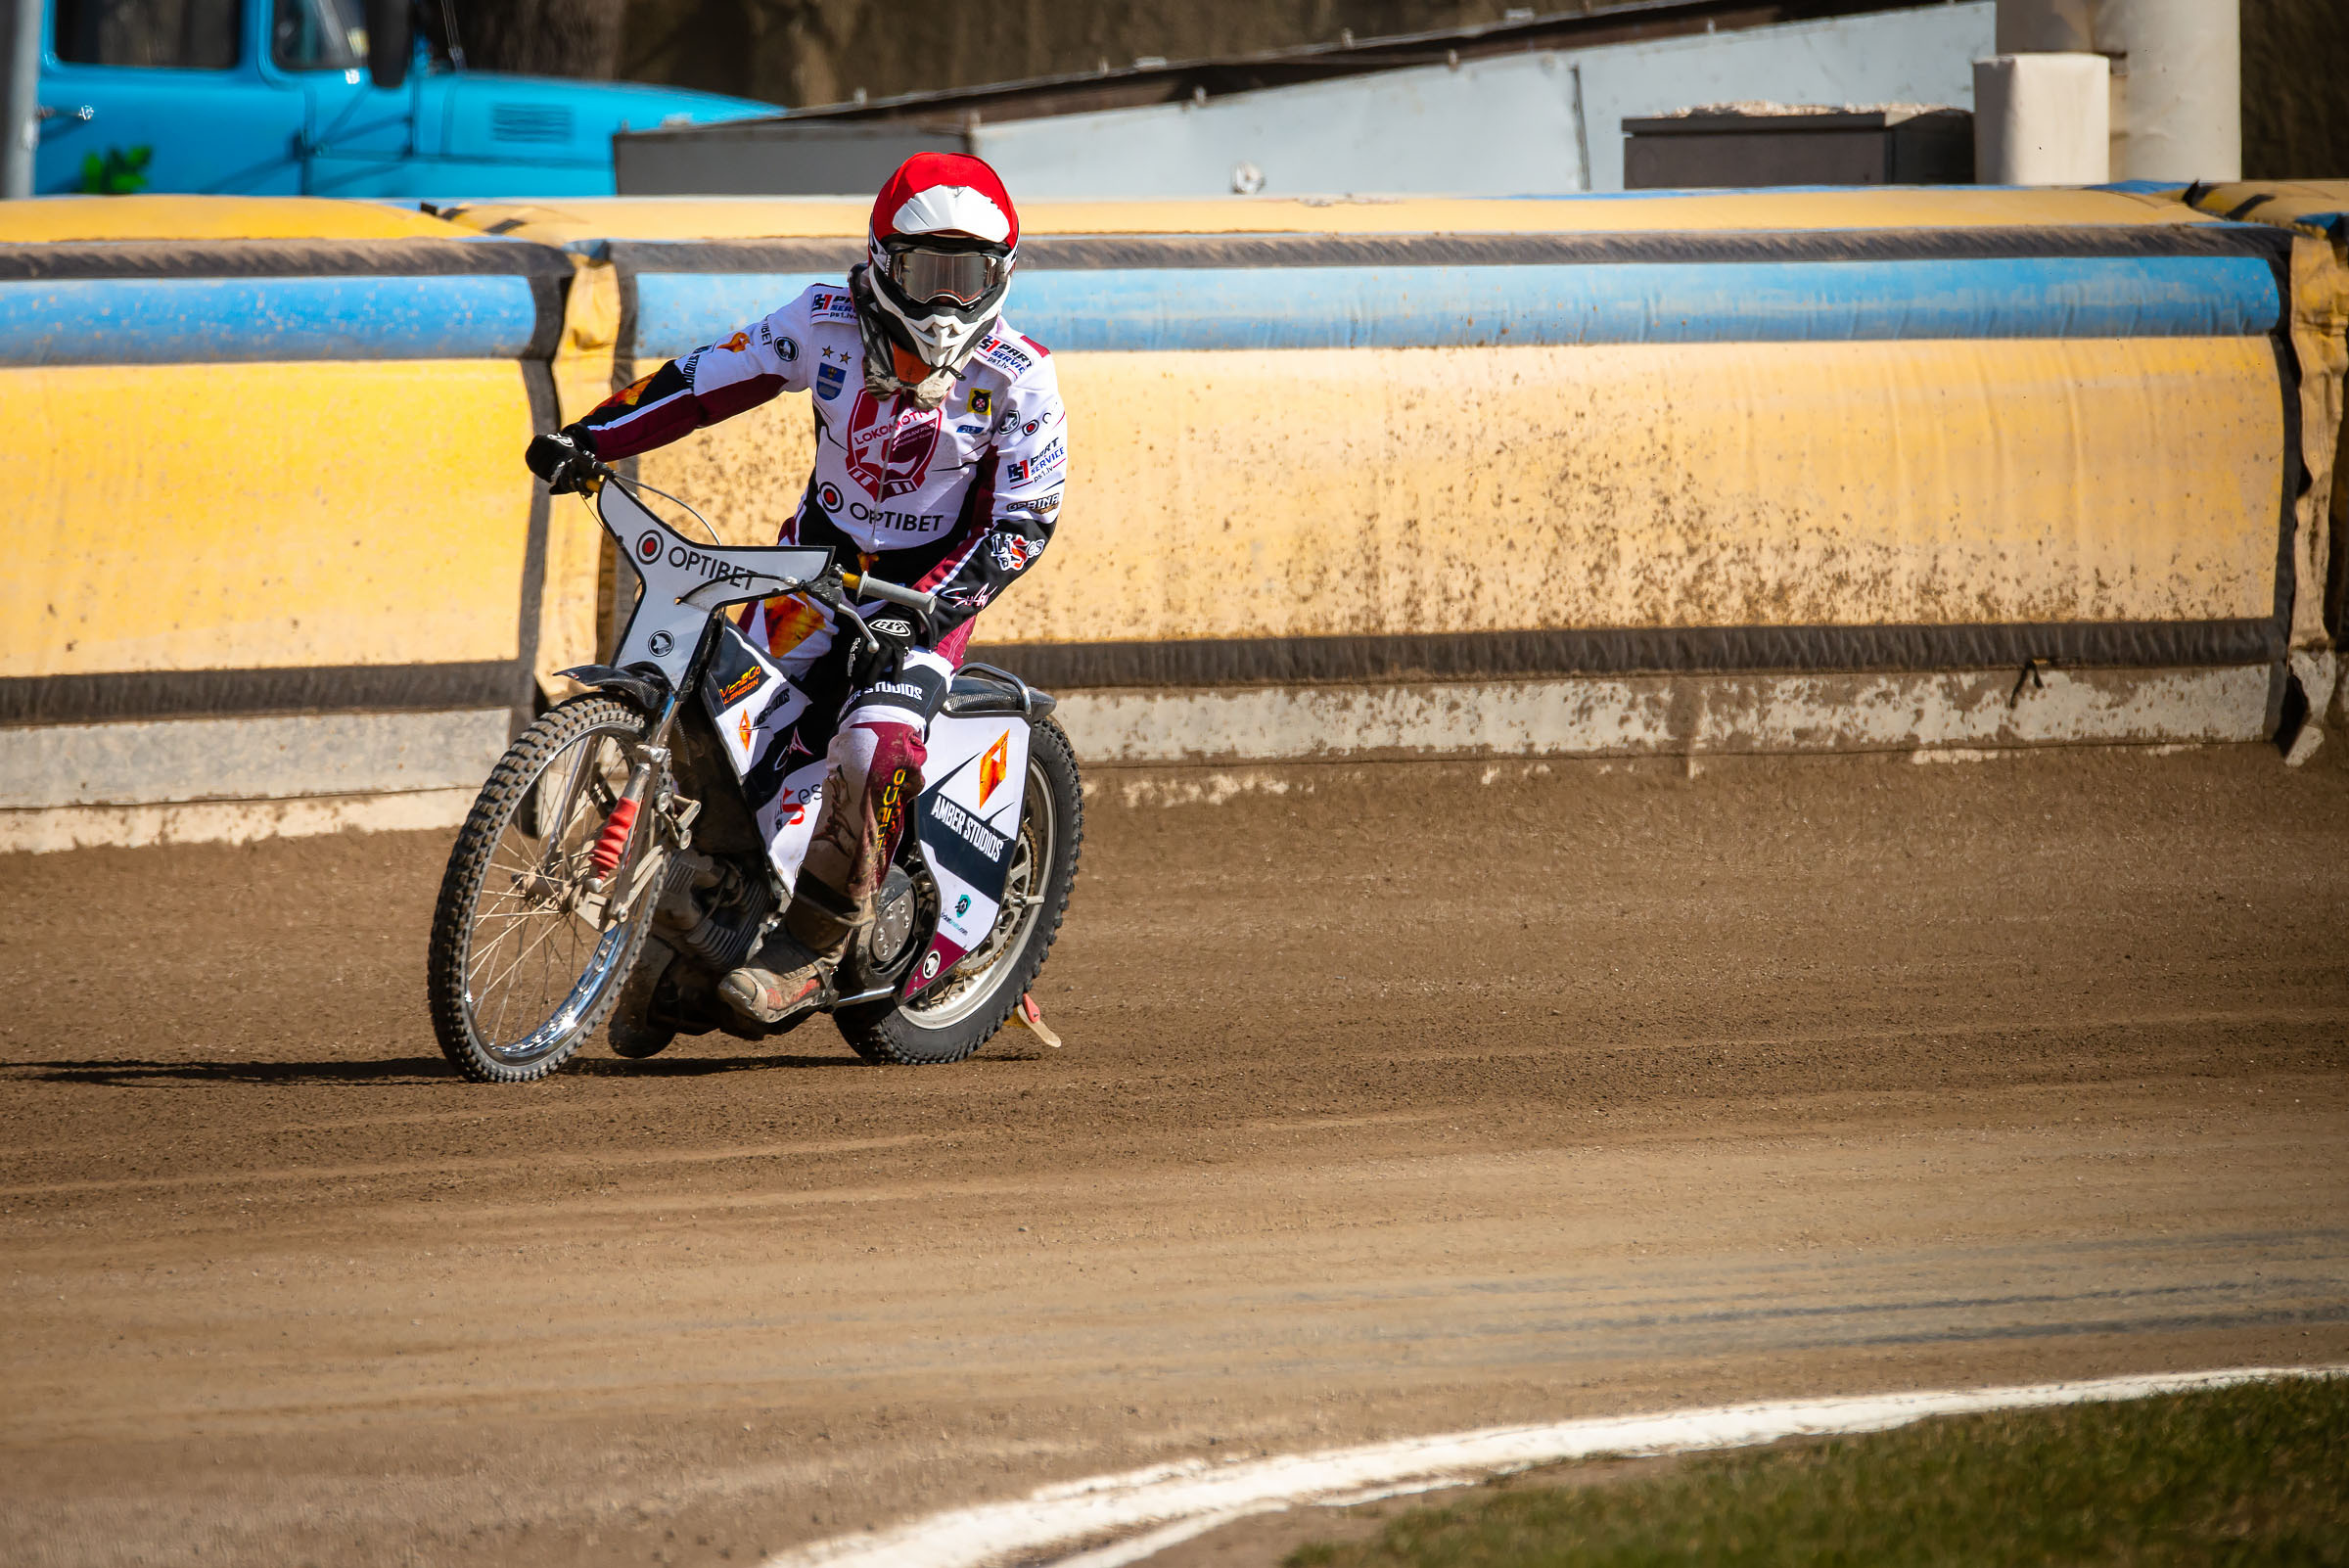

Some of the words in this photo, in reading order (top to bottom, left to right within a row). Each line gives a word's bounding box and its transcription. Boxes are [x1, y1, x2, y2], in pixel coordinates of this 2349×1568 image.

[990, 350, 1026, 375] SERVIC
[1030, 437, 1059, 466] PART
[1030, 446, 1065, 476] SERVICE
[850, 502, 944, 531] OPTIBET
[668, 546, 759, 590] OPTIBET
[931, 794, 967, 836] AMBER
[963, 815, 1005, 862] STUDIOS
